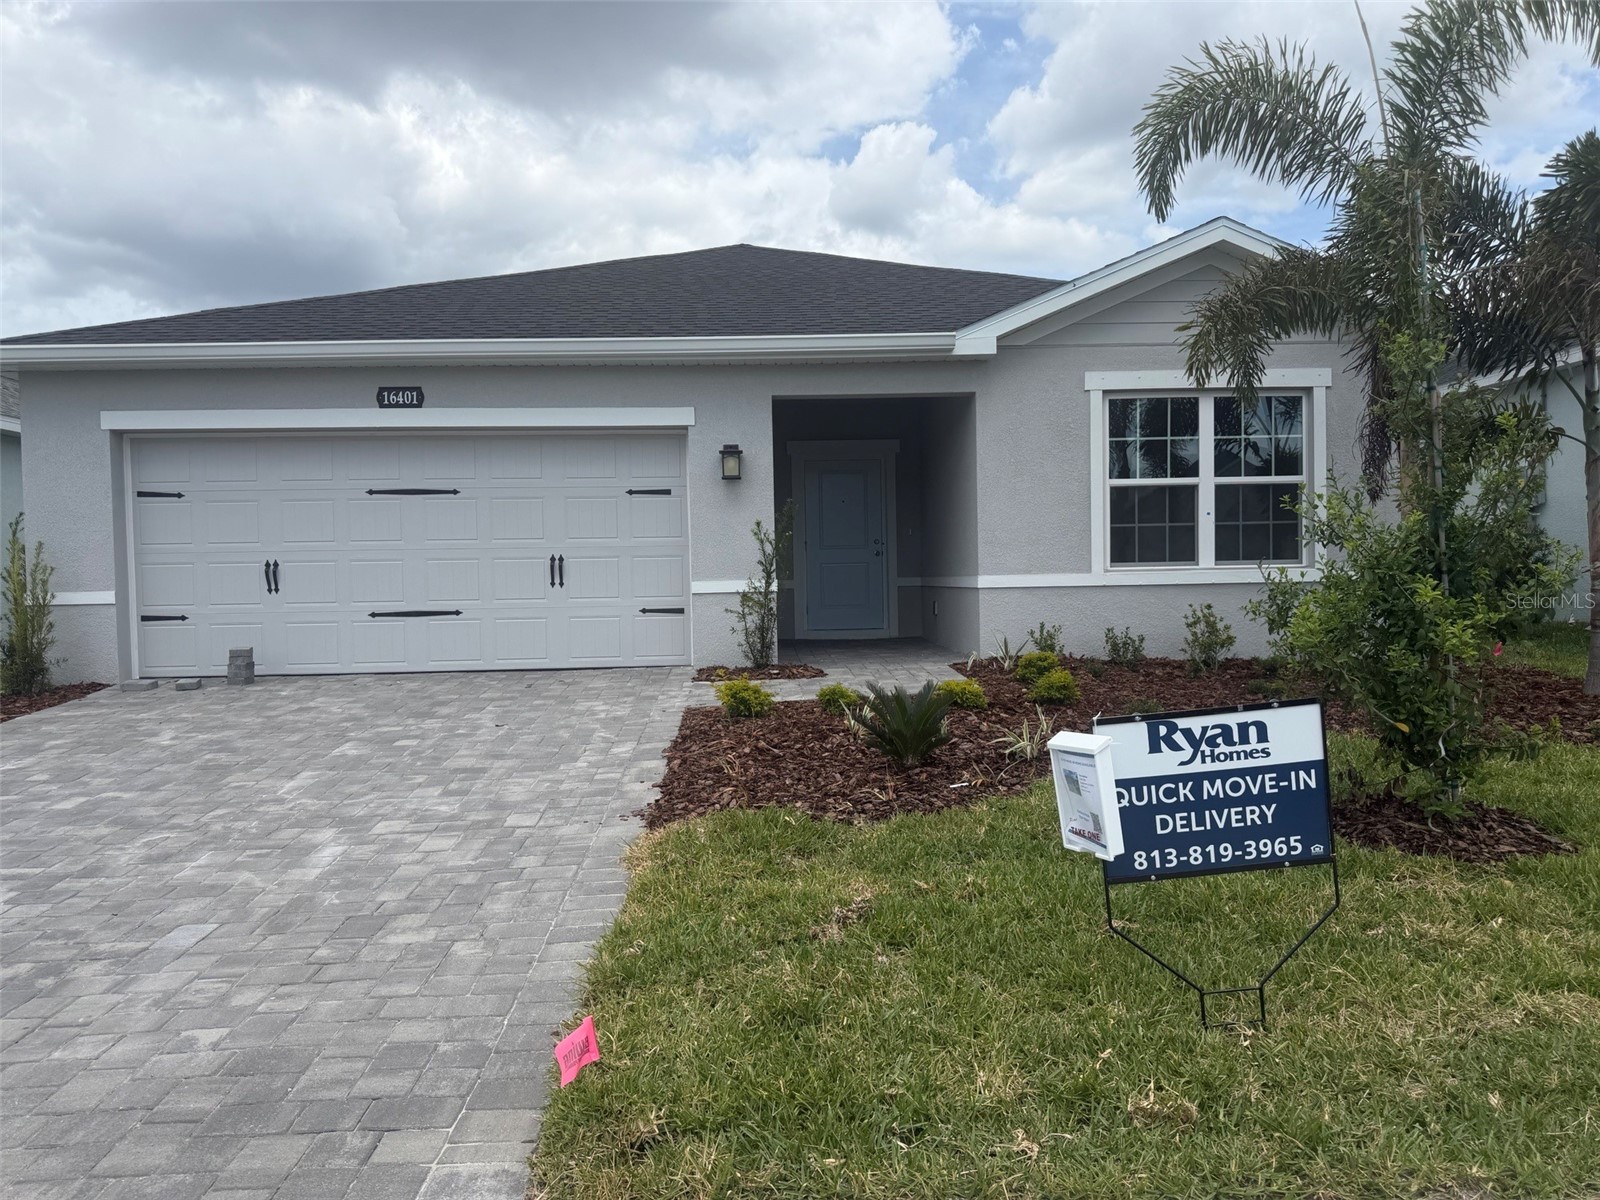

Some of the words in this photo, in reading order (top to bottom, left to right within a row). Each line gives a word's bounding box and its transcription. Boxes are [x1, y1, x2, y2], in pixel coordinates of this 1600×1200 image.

[383, 391, 418, 404] 16401
[1145, 720, 1270, 766] Ryan
[1201, 747, 1271, 764] Homes
[1115, 780, 1196, 808] QUICK
[1203, 769, 1316, 799] MOVE-IN
[1070, 826, 1086, 838] TAKE
[1087, 830, 1101, 841] ONE
[1155, 803, 1277, 835] DELIVERY
[1133, 836, 1303, 870] 813-819-3965
